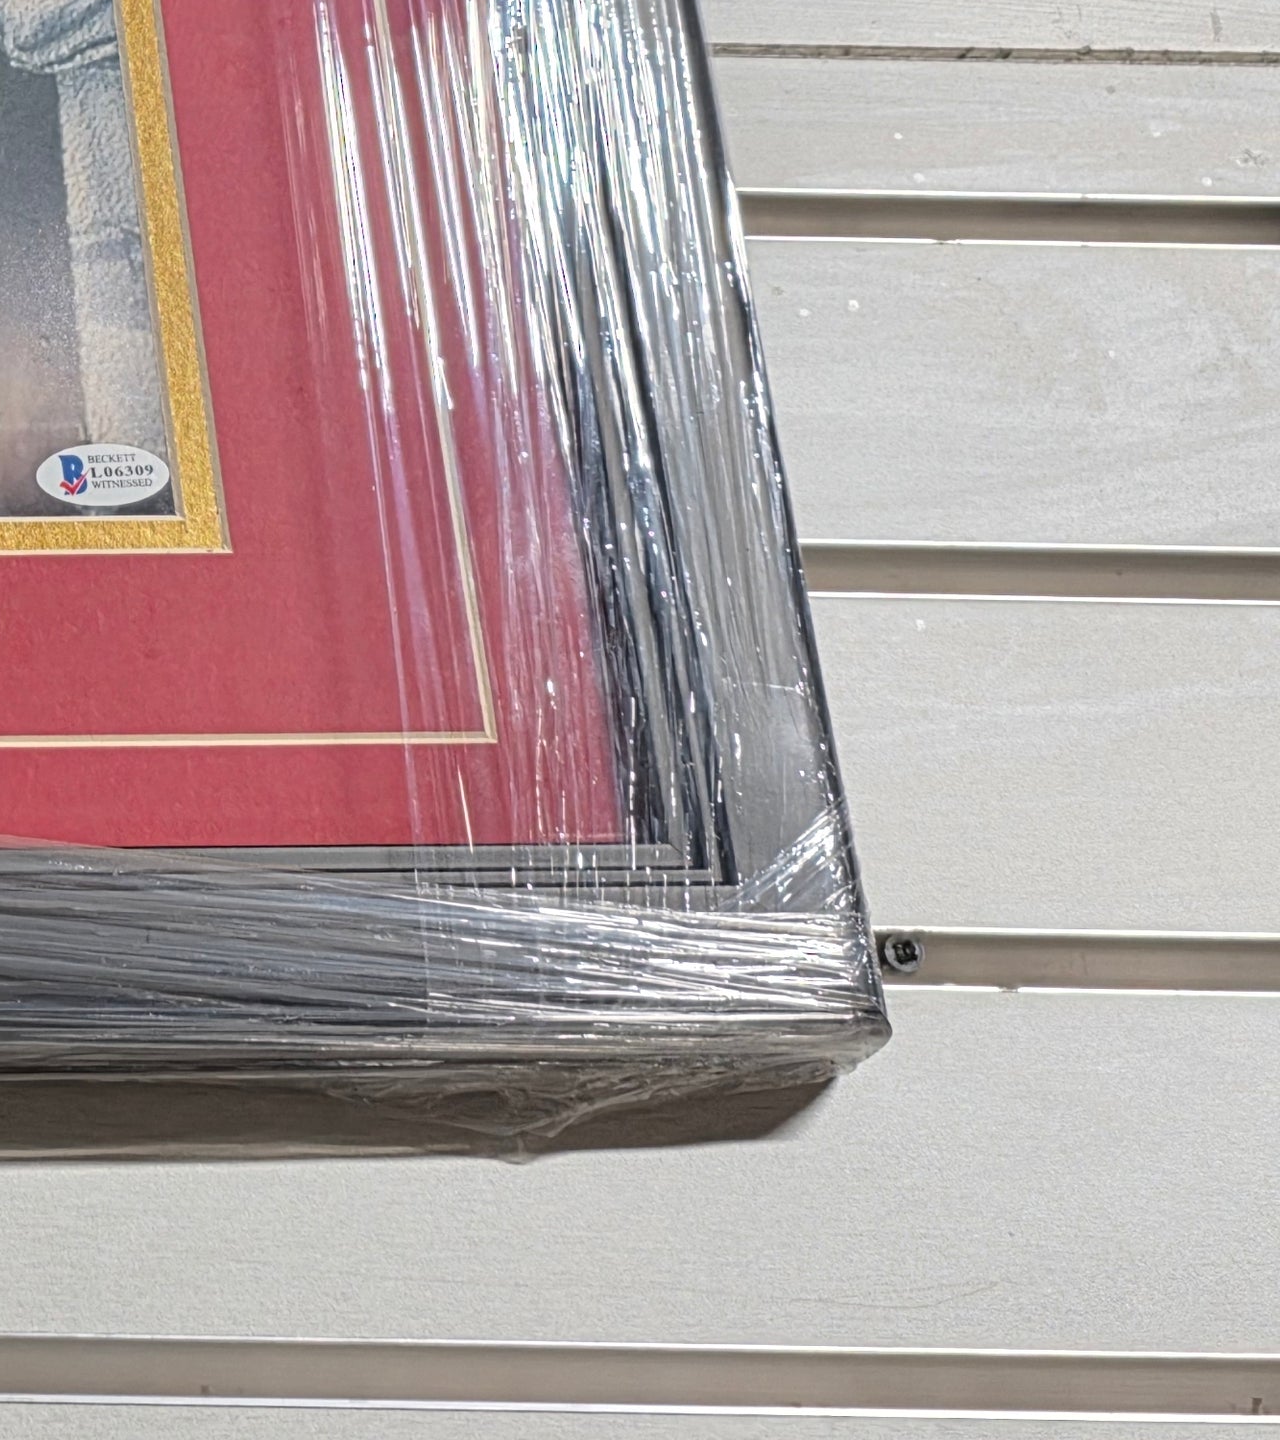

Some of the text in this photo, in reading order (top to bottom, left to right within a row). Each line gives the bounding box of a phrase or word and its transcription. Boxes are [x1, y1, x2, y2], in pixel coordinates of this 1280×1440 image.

[87, 453, 137, 464] BECKETT
[90, 464, 154, 479] L06309
[91, 478, 154, 489] WITNESSED
